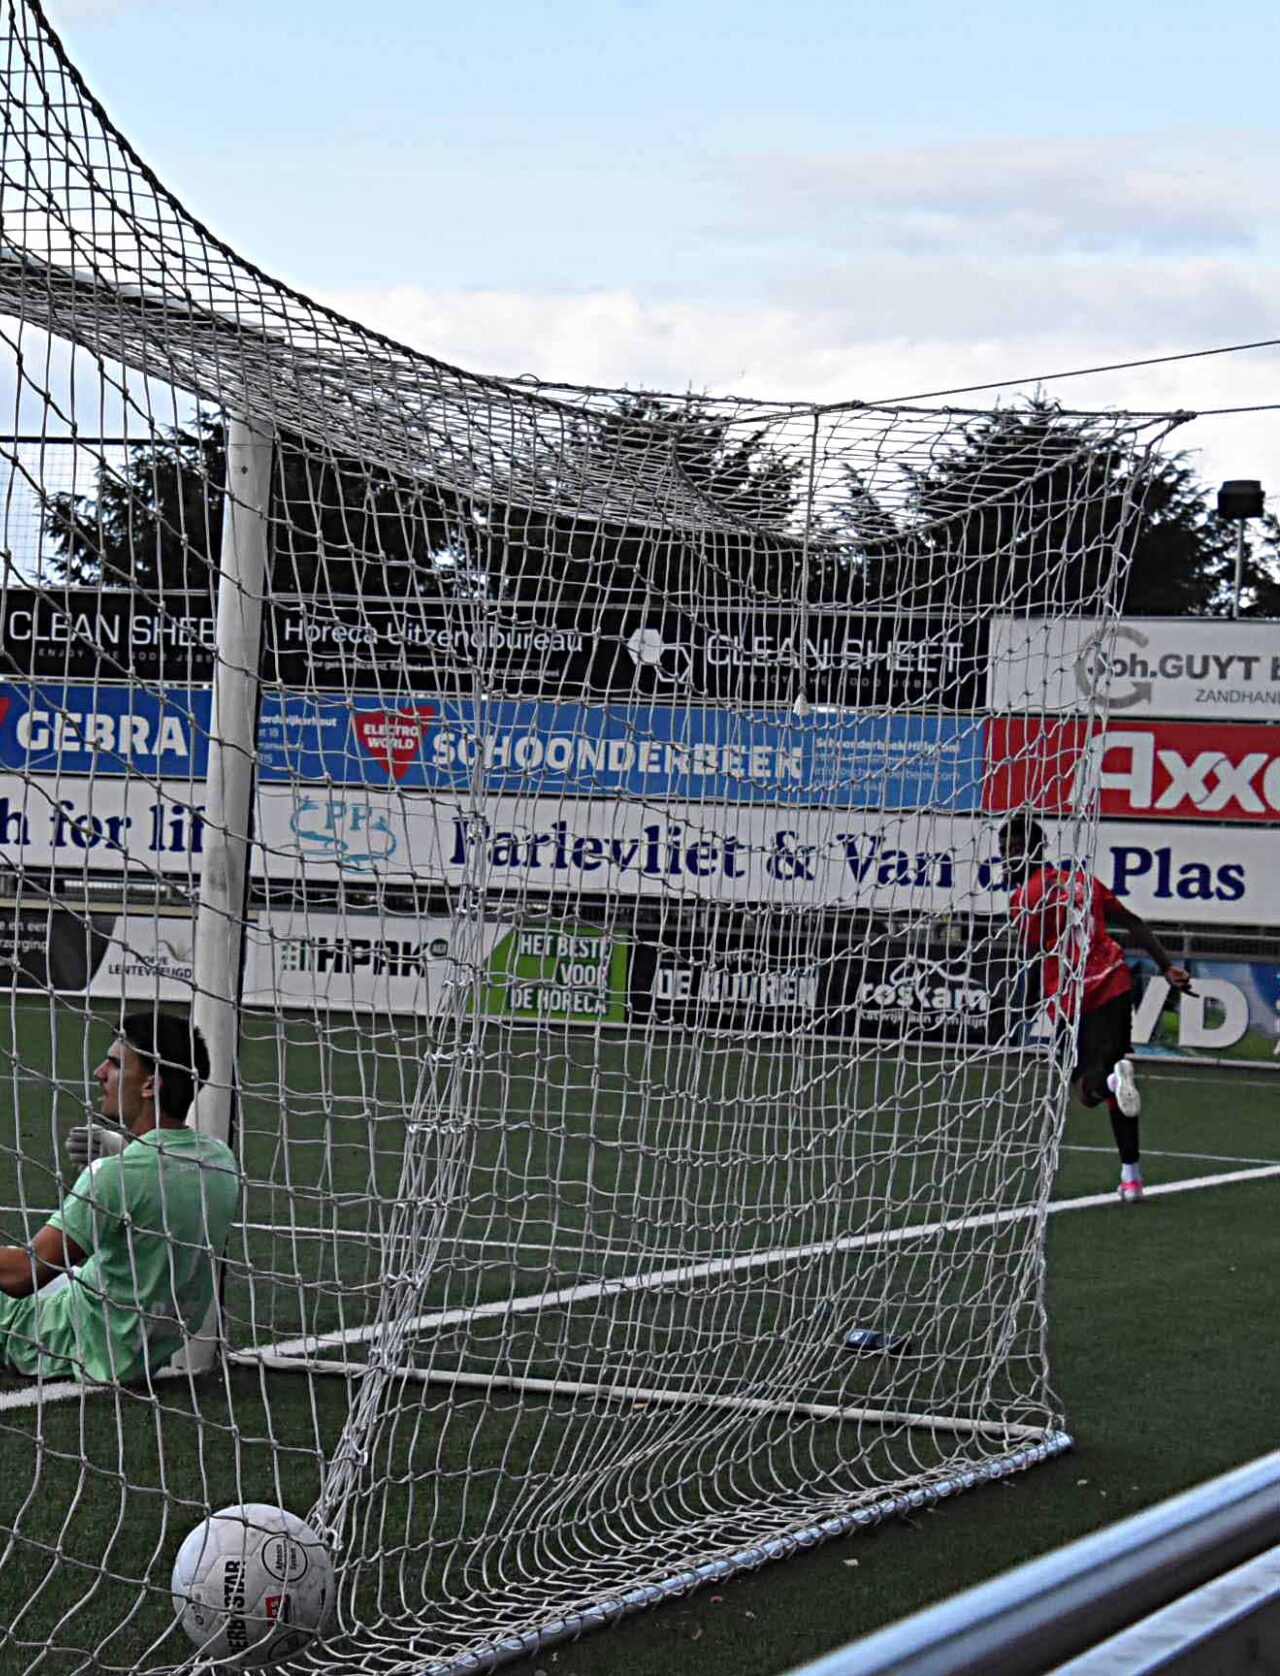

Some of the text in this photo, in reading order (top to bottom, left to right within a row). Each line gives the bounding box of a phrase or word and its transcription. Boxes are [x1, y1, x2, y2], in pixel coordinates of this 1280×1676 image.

[9, 609, 120, 644] CLEAN
[284, 617, 379, 646] Horeca
[1195, 688, 1280, 704] ZANDHAN
[15, 710, 190, 757] GEBRA
[49, 800, 132, 850] for
[766, 830, 817, 881] &
[835, 833, 953, 888] Van
[1109, 846, 1246, 901] Plas
[520, 934, 554, 956] HET
[510, 988, 534, 1009] DE
